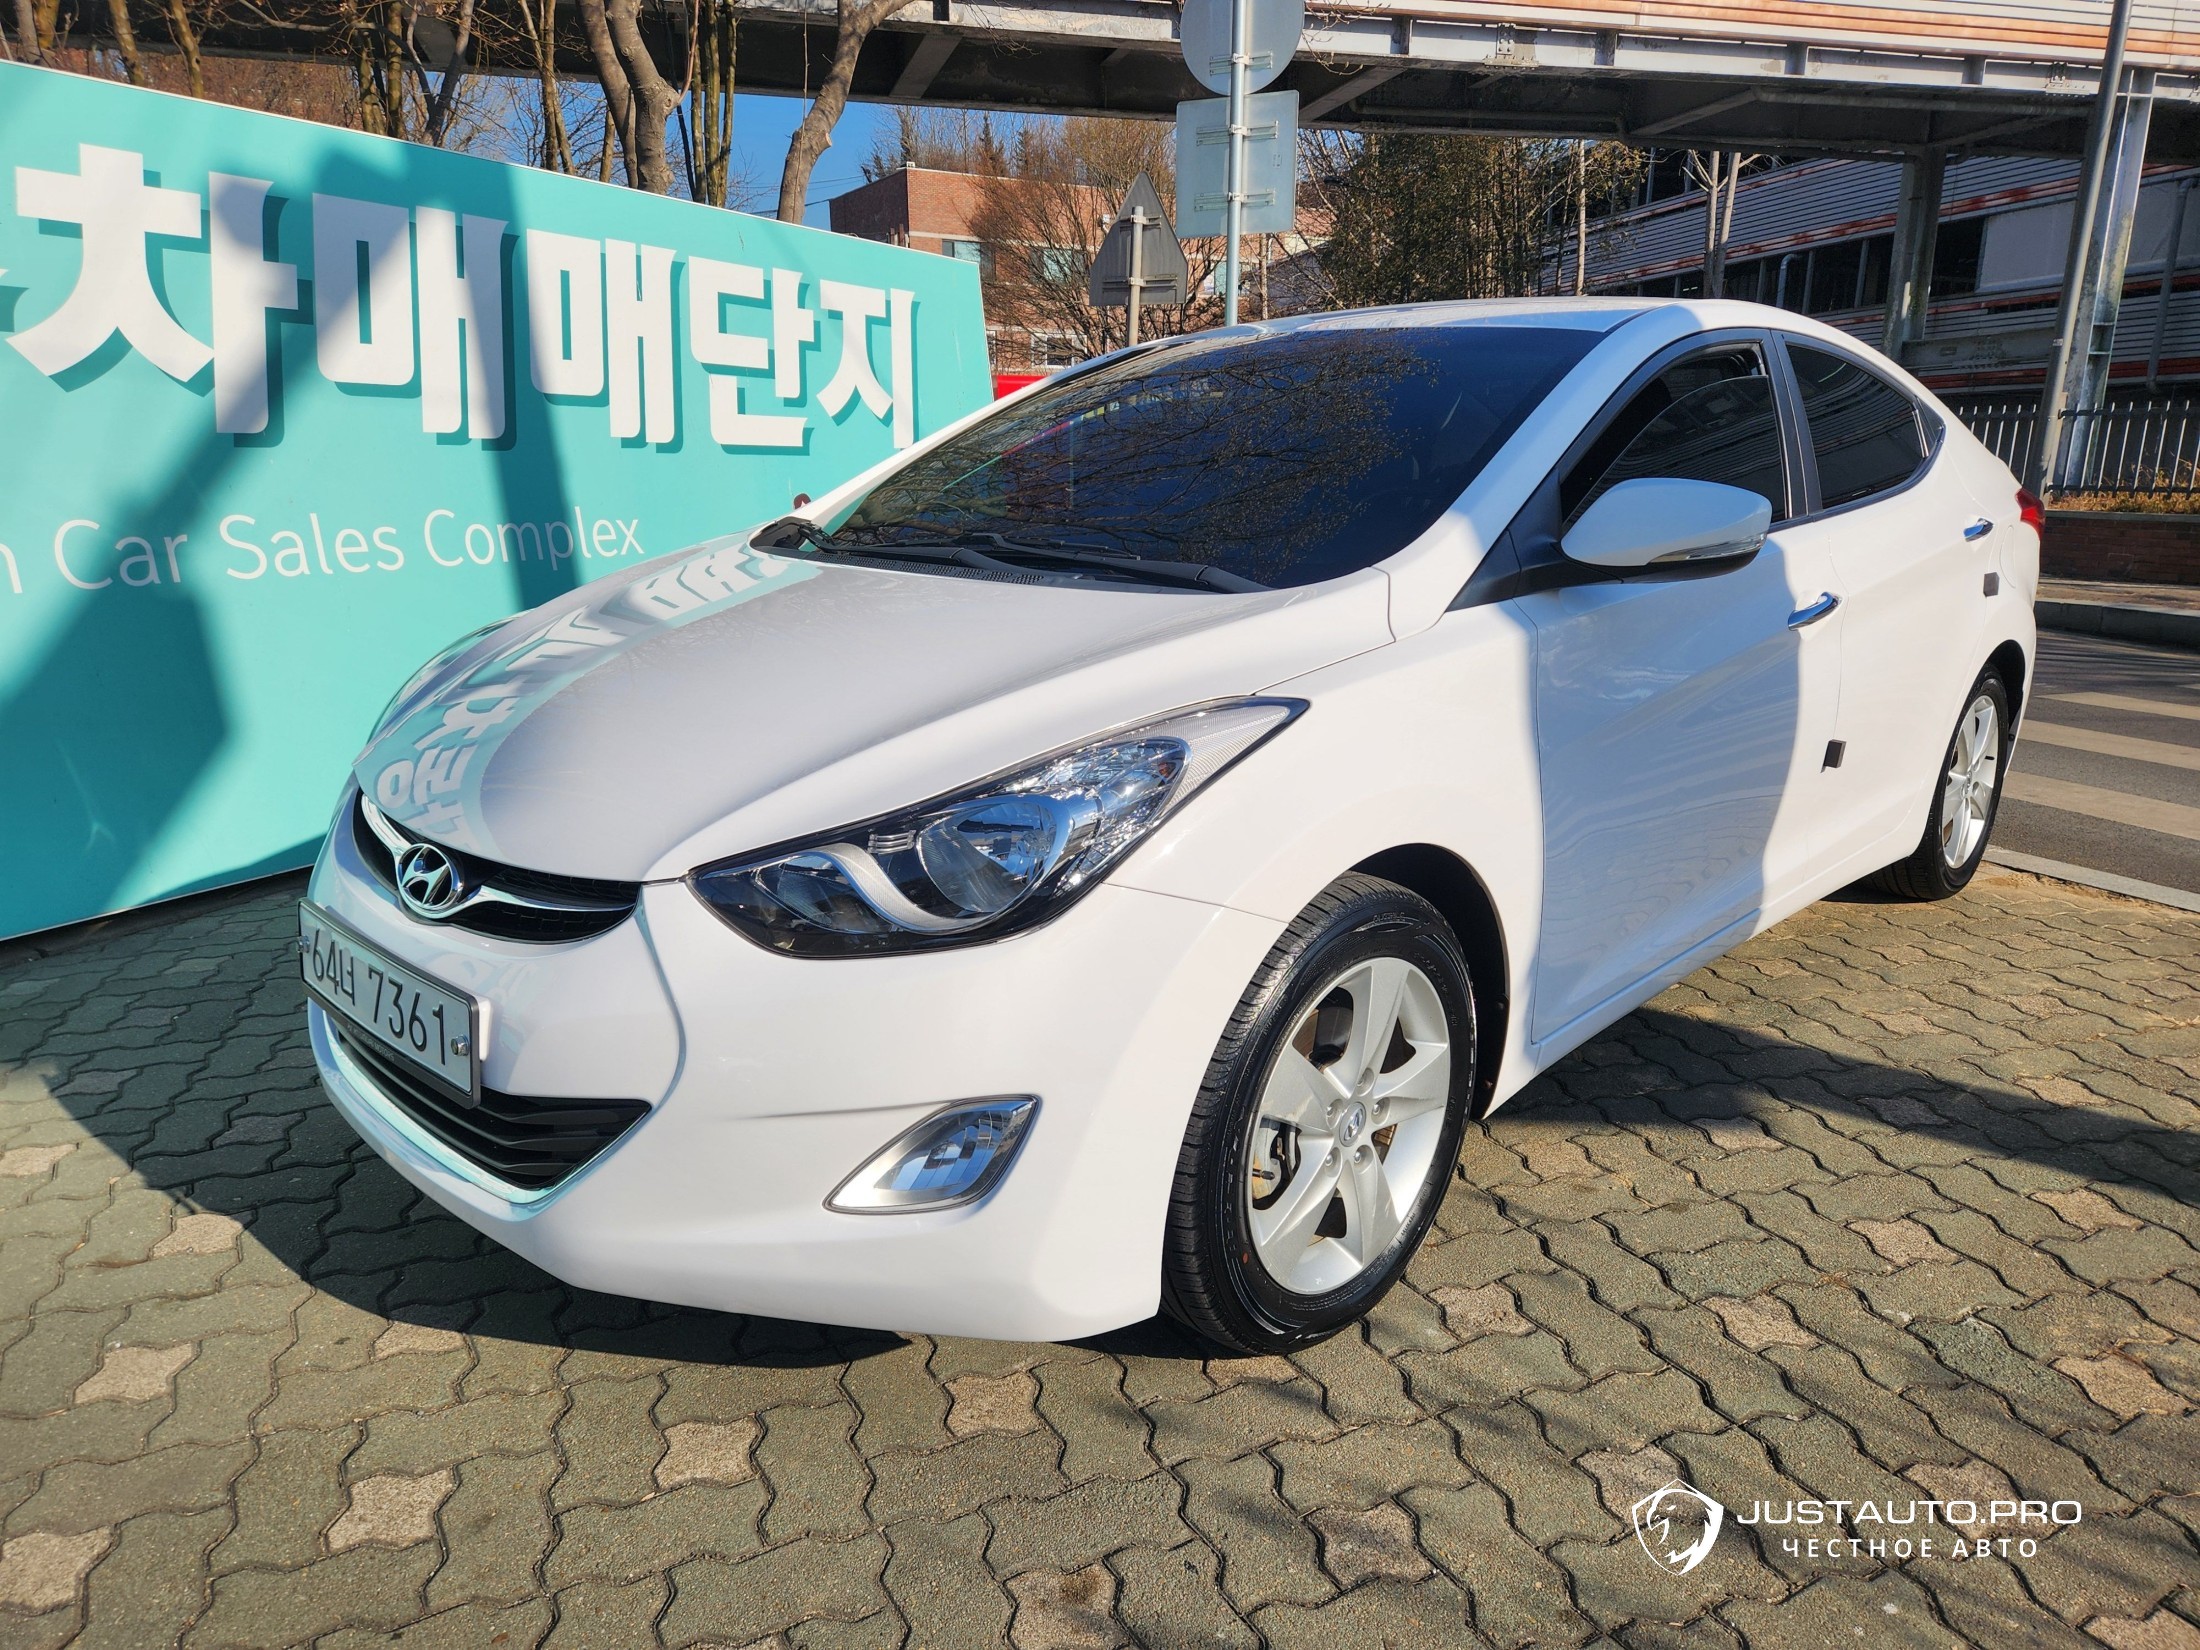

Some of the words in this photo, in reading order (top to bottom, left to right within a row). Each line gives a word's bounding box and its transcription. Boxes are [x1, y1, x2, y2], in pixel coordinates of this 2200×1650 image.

[0, 142, 916, 450] 차매매단지
[54, 518, 188, 591] Car
[219, 512, 405, 580] Sales
[423, 506, 645, 571] Complex
[368, 965, 446, 1066] 7361
